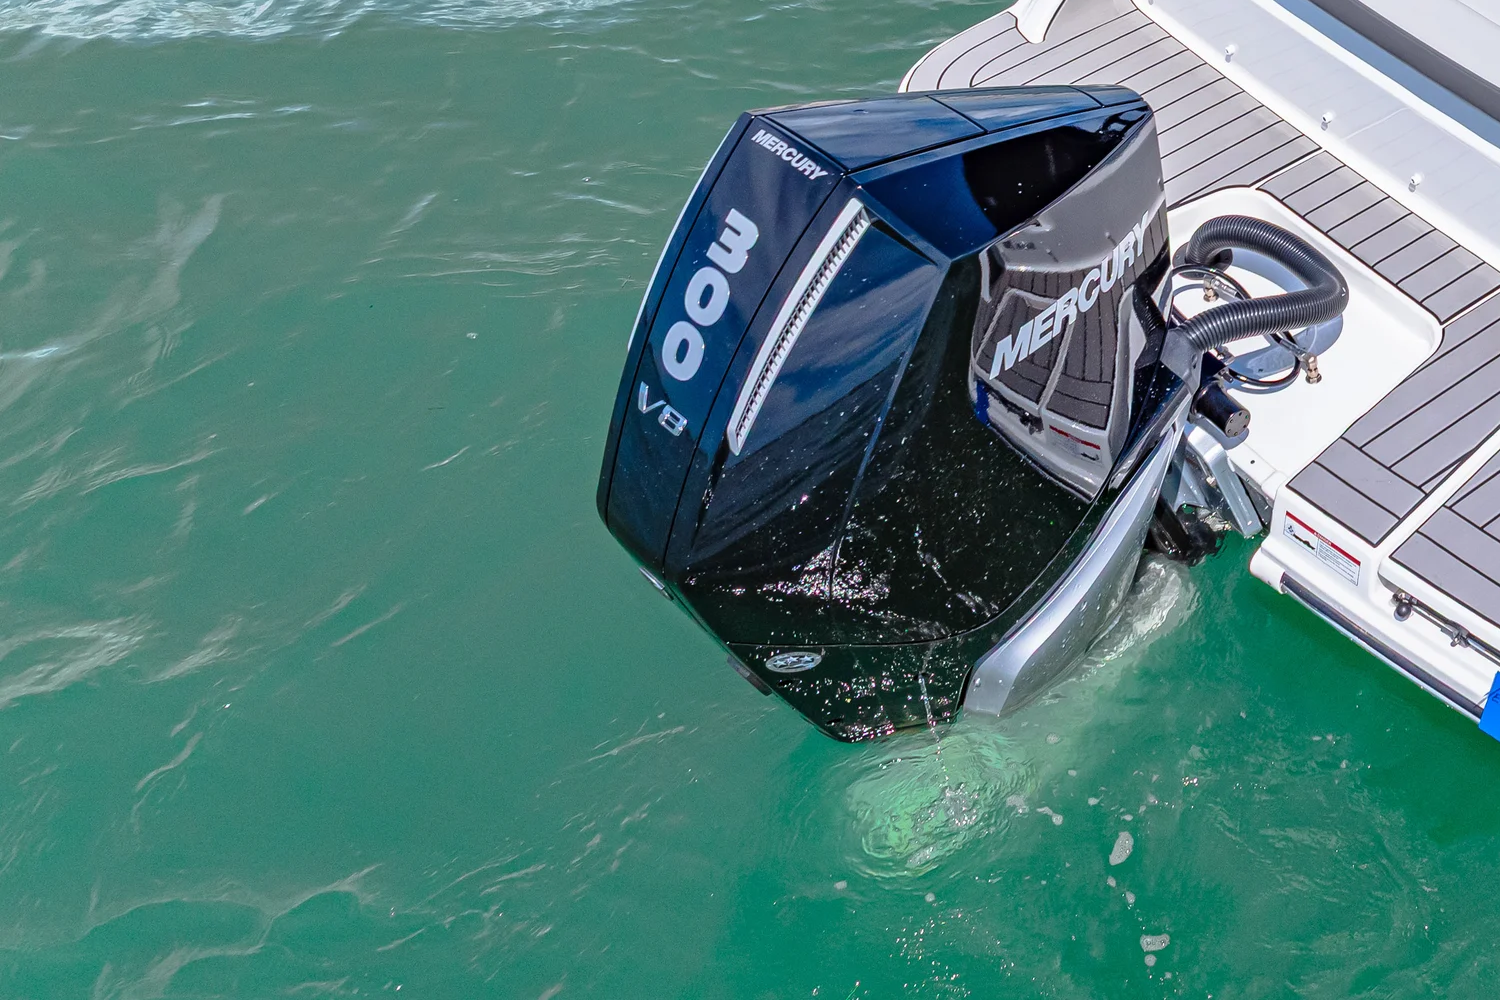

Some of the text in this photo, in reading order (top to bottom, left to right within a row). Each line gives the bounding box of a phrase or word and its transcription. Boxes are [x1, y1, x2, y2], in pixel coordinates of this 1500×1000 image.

[751, 129, 828, 180] MERCURY
[661, 207, 760, 382] 300
[988, 210, 1149, 381] MERCURY
[637, 381, 688, 437] V8
